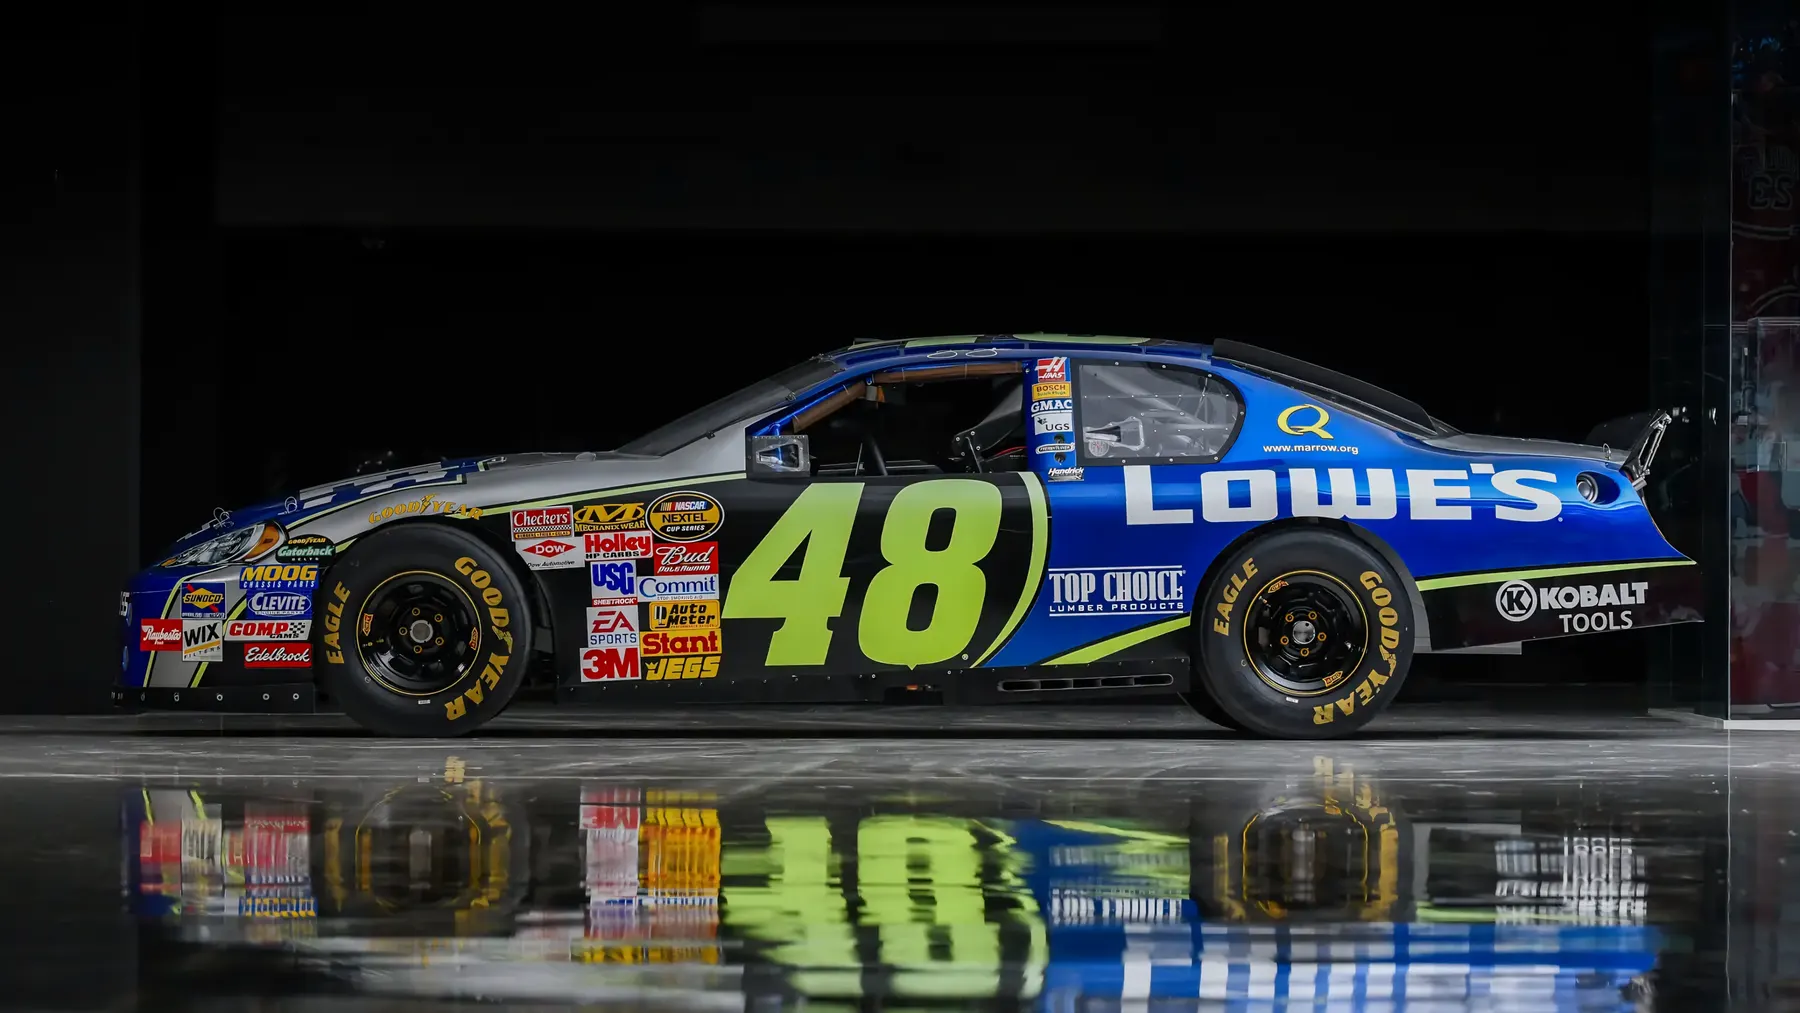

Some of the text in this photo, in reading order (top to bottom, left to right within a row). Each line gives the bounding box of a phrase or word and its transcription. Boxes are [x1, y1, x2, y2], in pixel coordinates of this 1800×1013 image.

[1036, 384, 1066, 392] BOSCH
[1031, 399, 1072, 413] GMAC
[1045, 423, 1069, 431] UGS
[1277, 403, 1334, 440] Q
[1263, 444, 1359, 455] www.marrow.org
[1048, 467, 1084, 476] Hendrick
[1123, 463, 1562, 526] LOWE'S
[368, 493, 483, 524] GOODYEAR
[674, 501, 707, 511] NASCAR
[513, 508, 568, 527] Checkers
[574, 519, 645, 532] MECHANIX WEAR
[662, 512, 707, 523] NEXTEL
[277, 545, 334, 556] Gatorback
[535, 545, 566, 554] DOW
[585, 533, 651, 557] Holley
[603, 550, 640, 558] CARBS
[656, 545, 715, 565] Bud
[241, 565, 318, 581] MOOG
[657, 565, 681, 574] POLE
[721, 478, 1003, 671] 48
[592, 562, 634, 595] USG
[639, 576, 715, 597] Commit
[1049, 571, 1183, 603] TOP CHOICE
[185, 594, 222, 603] SUNOCO
[252, 592, 306, 610] CLEVITE
[593, 598, 634, 606] SHEETROCK
[1213, 557, 1259, 637] EAGLE
[1539, 581, 1648, 610] KOBALT
[670, 603, 707, 614] Auto
[1049, 602, 1183, 612] LUMBER PRODUCTS
[324, 581, 351, 664] EAGLE
[591, 610, 635, 633] EA
[667, 614, 715, 625] Meter
[1558, 611, 1633, 633] TOOLS
[184, 622, 220, 648] WIX
[229, 622, 289, 636] COMP
[444, 556, 514, 721] GOODYEAR
[590, 633, 637, 645] SPORTS
[642, 631, 718, 655] Stant
[184, 646, 220, 659] FILTERS
[245, 646, 310, 662] Edelbrock
[1313, 570, 1400, 725] GOODYEAR
[583, 647, 639, 680] 3M
[646, 656, 721, 680] JEGS
